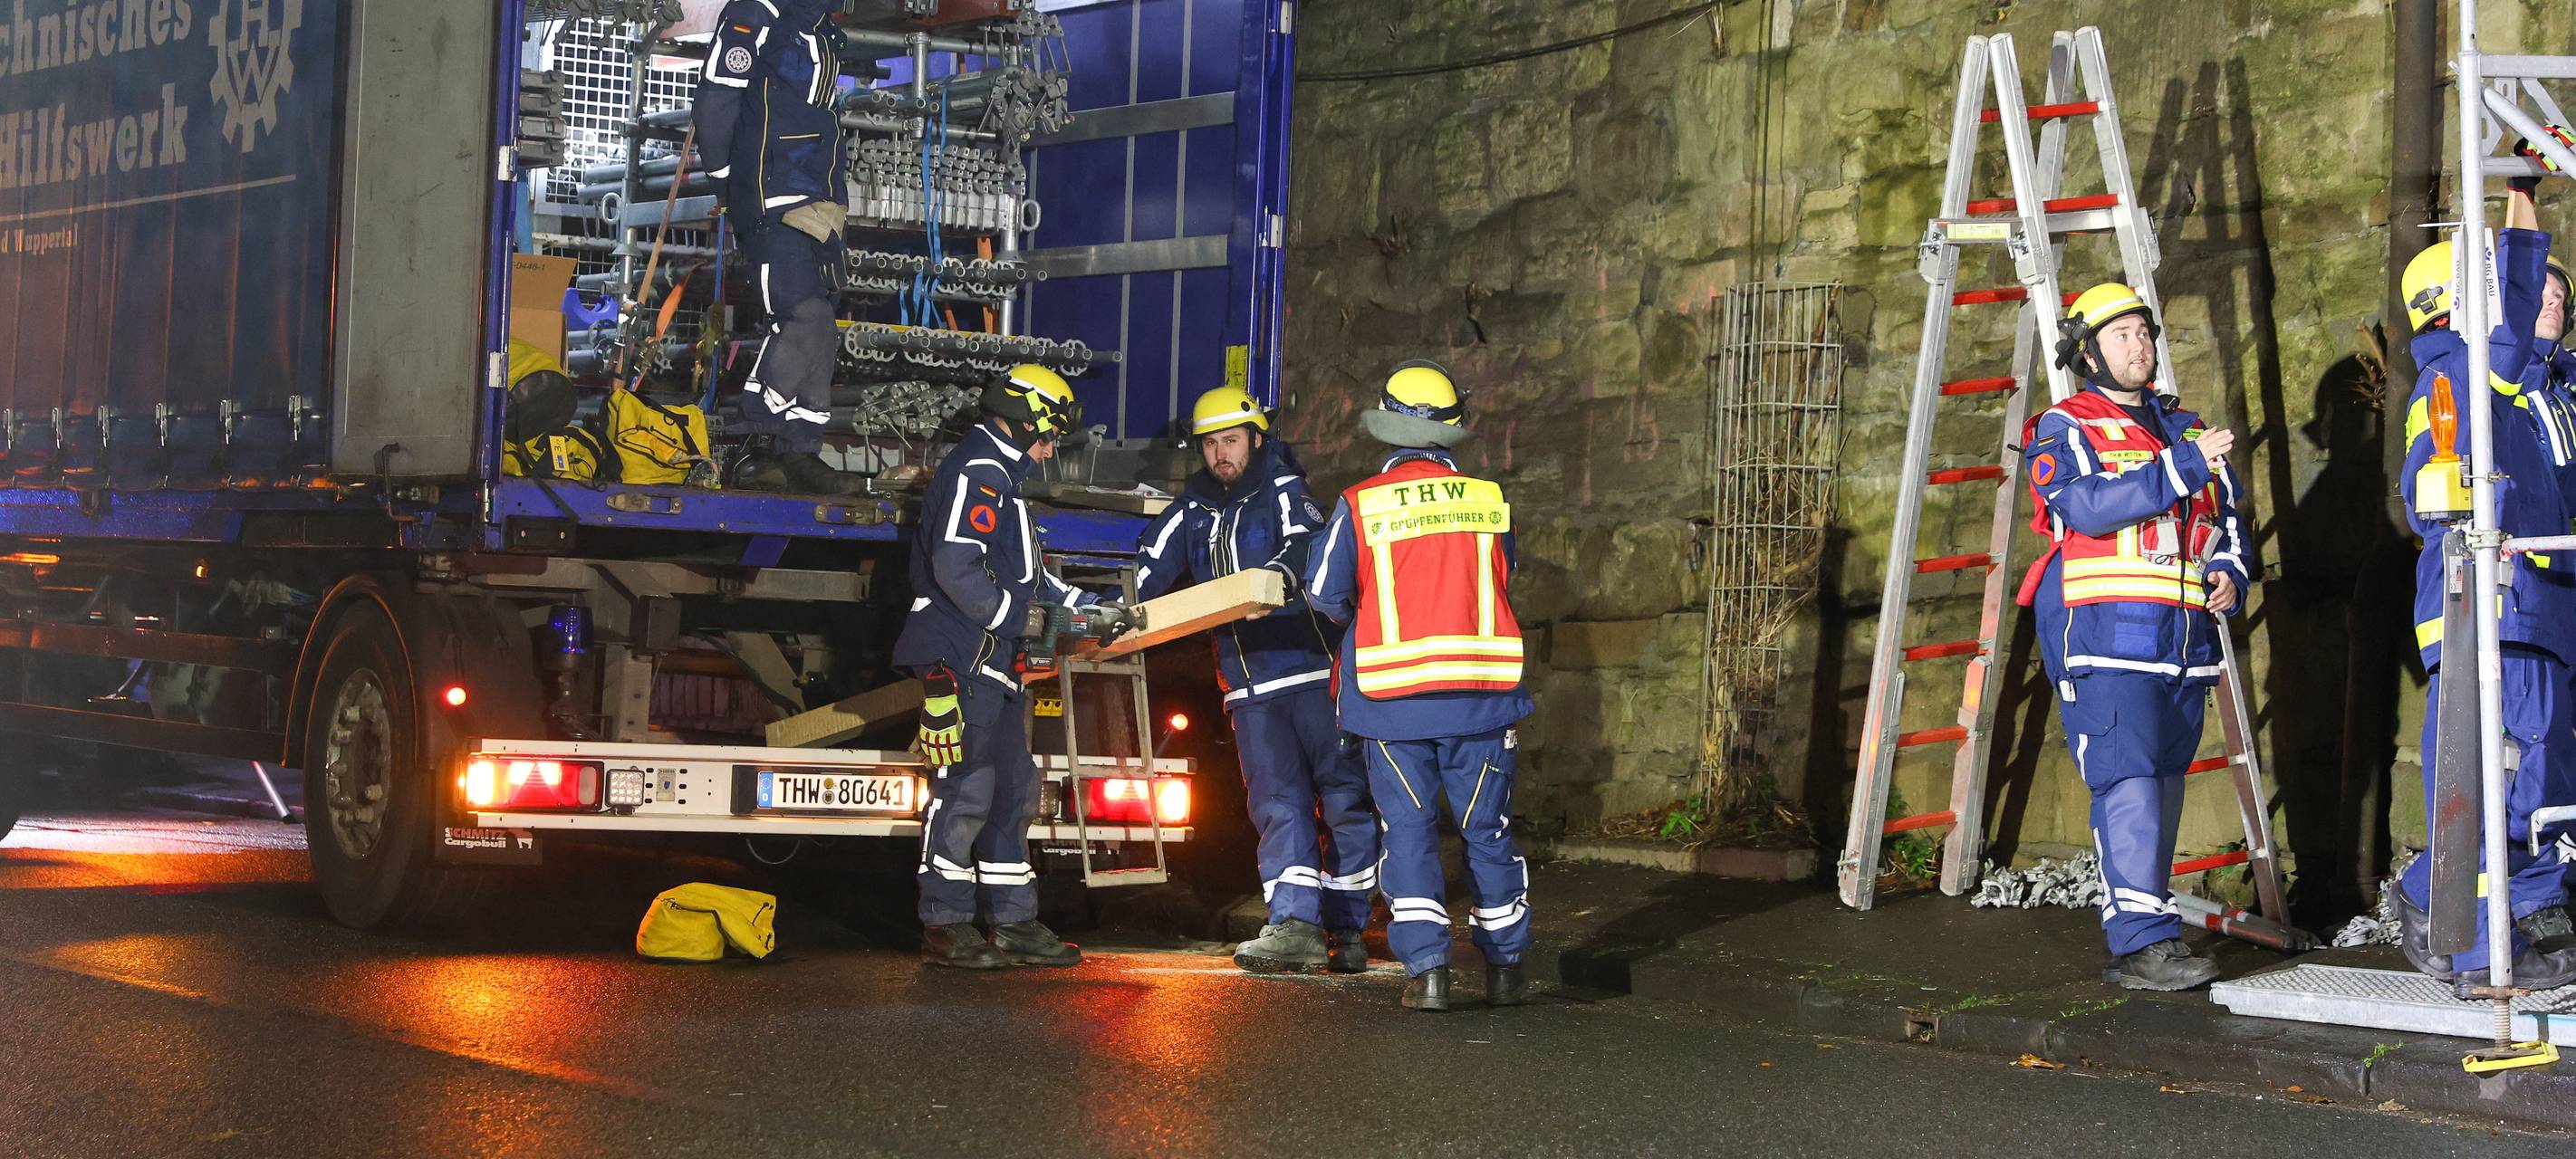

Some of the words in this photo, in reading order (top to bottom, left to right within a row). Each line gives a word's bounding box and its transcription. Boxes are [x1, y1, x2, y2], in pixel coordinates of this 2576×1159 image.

[0, 82, 188, 189] Hilfswerk
[14, 223, 79, 255] Wuppertal
[2485, 263, 2493, 276] BG
[2485, 277, 2495, 297] BAU
[1394, 482, 1467, 506] THW
[779, 778, 821, 804] THW
[838, 779, 905, 806] 80641
[444, 837, 506, 848] Cargobull
[445, 827, 507, 840] SCHMITZ
